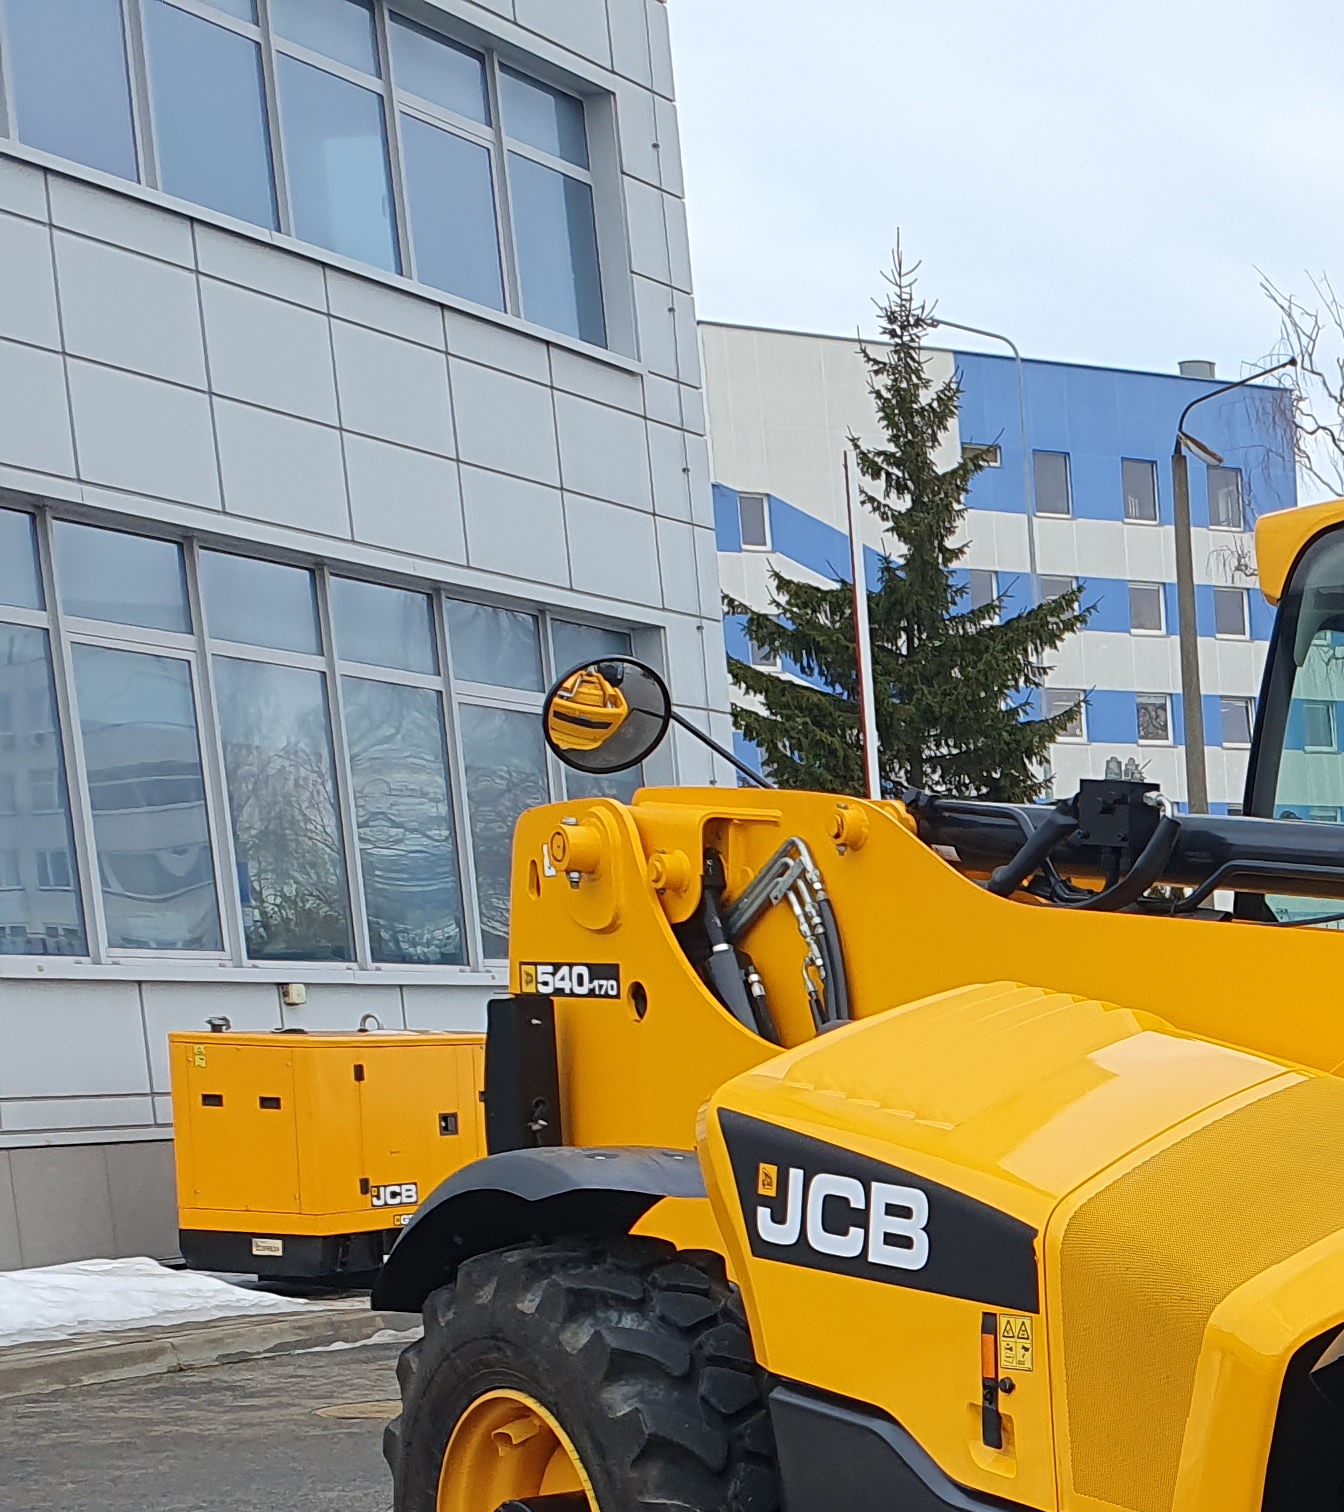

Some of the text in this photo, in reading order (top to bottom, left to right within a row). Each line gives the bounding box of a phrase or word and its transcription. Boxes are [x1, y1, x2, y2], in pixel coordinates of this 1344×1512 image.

[536, 965, 618, 996] 540-170
[371, 1184, 417, 1206] JCB
[757, 1167, 930, 1271] JCB
